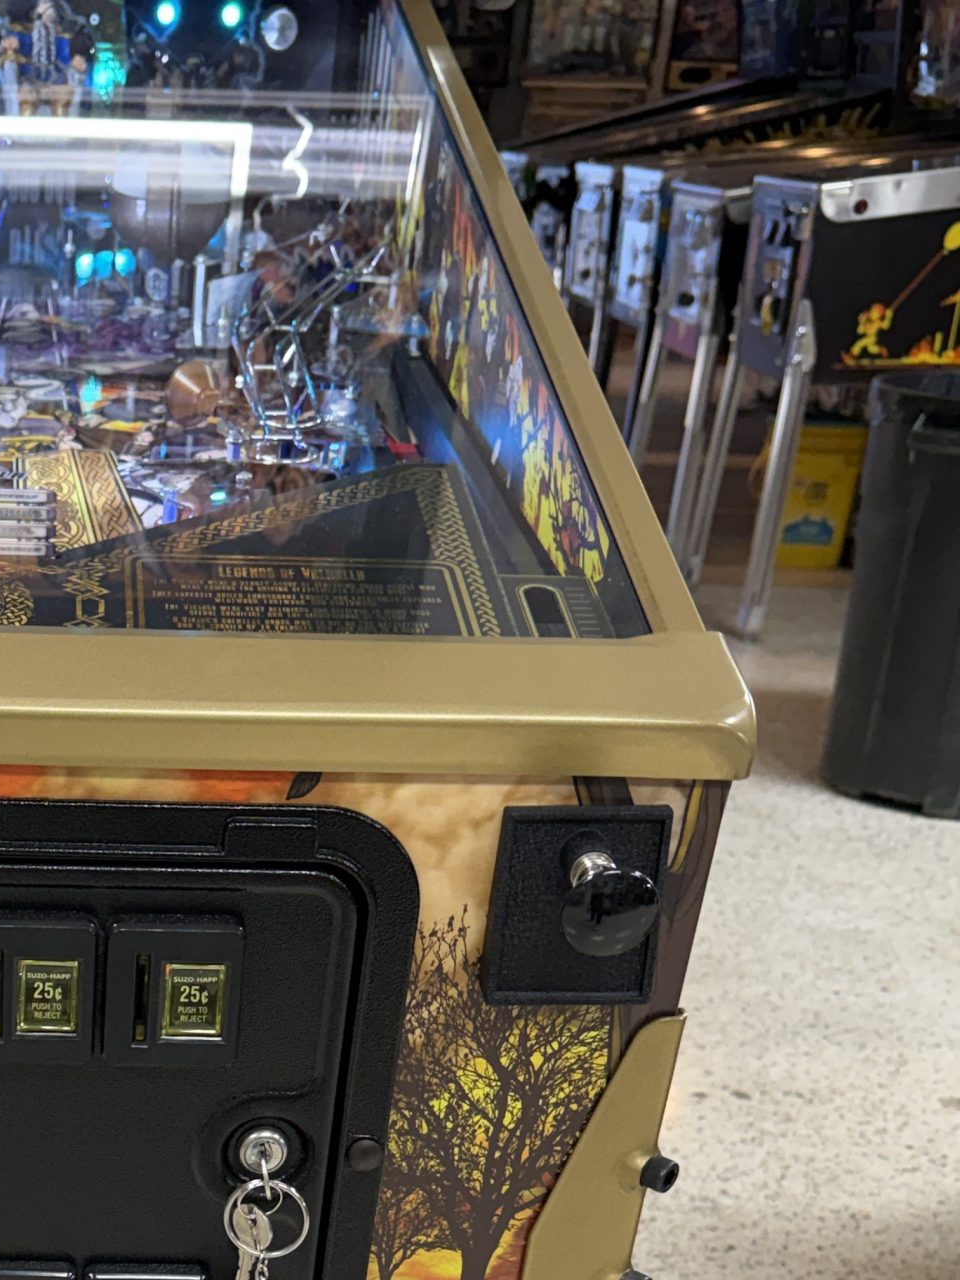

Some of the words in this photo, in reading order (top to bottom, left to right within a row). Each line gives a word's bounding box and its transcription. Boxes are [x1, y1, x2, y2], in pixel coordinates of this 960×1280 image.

[26, 972, 71, 980] SUZO-HAPP
[33, 981, 63, 1000] 25¢
[179, 985, 209, 1004] 25¢
[31, 1002, 50, 1011] PUSH
[51, 1003, 62, 1011] TO
[178, 1006, 196, 1014] PUSH
[198, 1006, 208, 1014] TO
[34, 1010, 61, 1019] REJECT
[179, 1014, 207, 1022] REJECT
